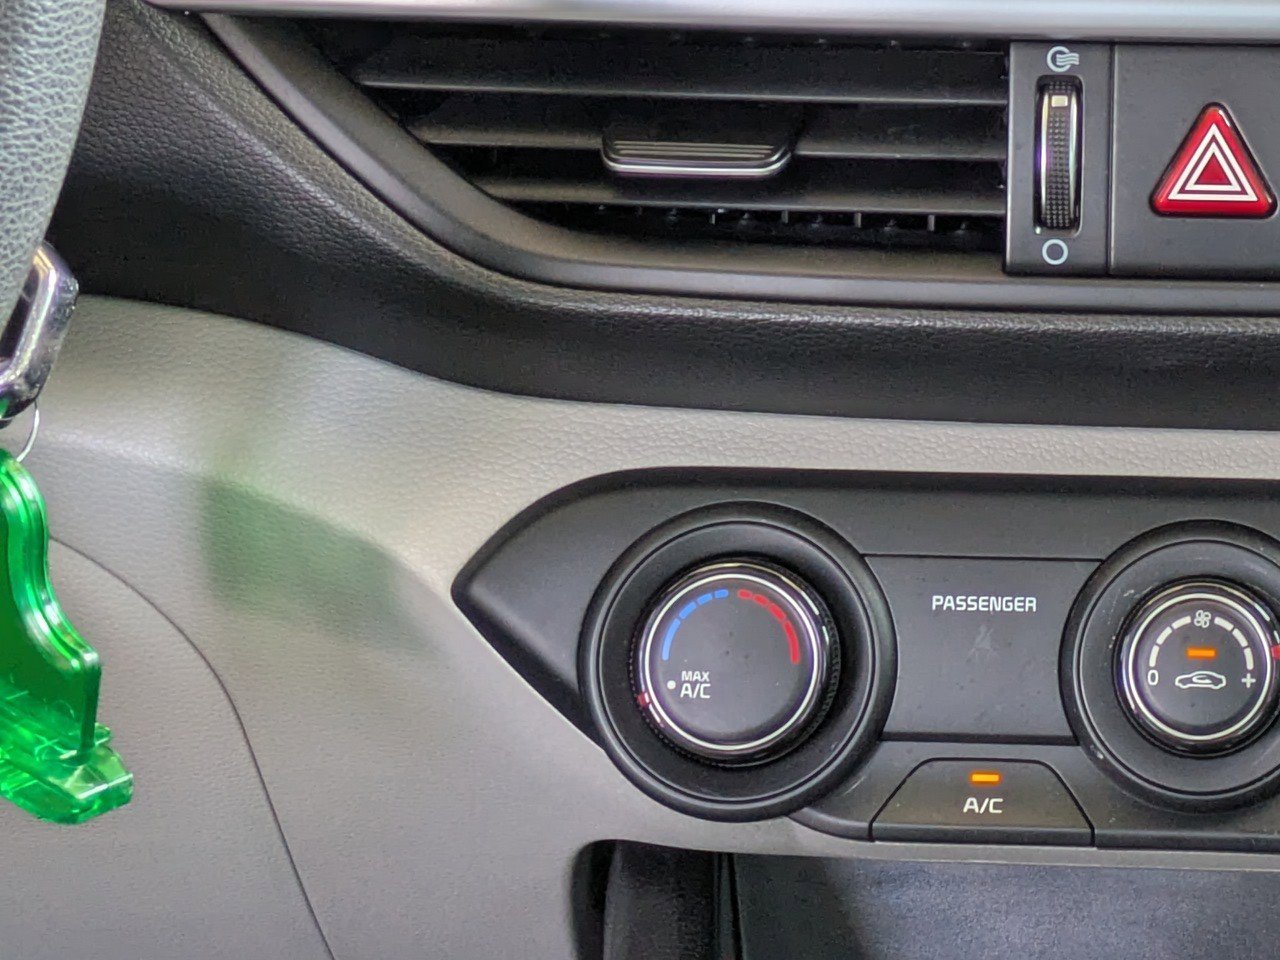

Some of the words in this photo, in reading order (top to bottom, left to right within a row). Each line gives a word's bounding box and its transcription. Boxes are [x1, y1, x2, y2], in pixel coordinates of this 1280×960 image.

[931, 594, 1038, 614] PASSENGER
[681, 670, 711, 683] MAX
[680, 681, 712, 700] A/C
[962, 797, 1004, 815] A/C
